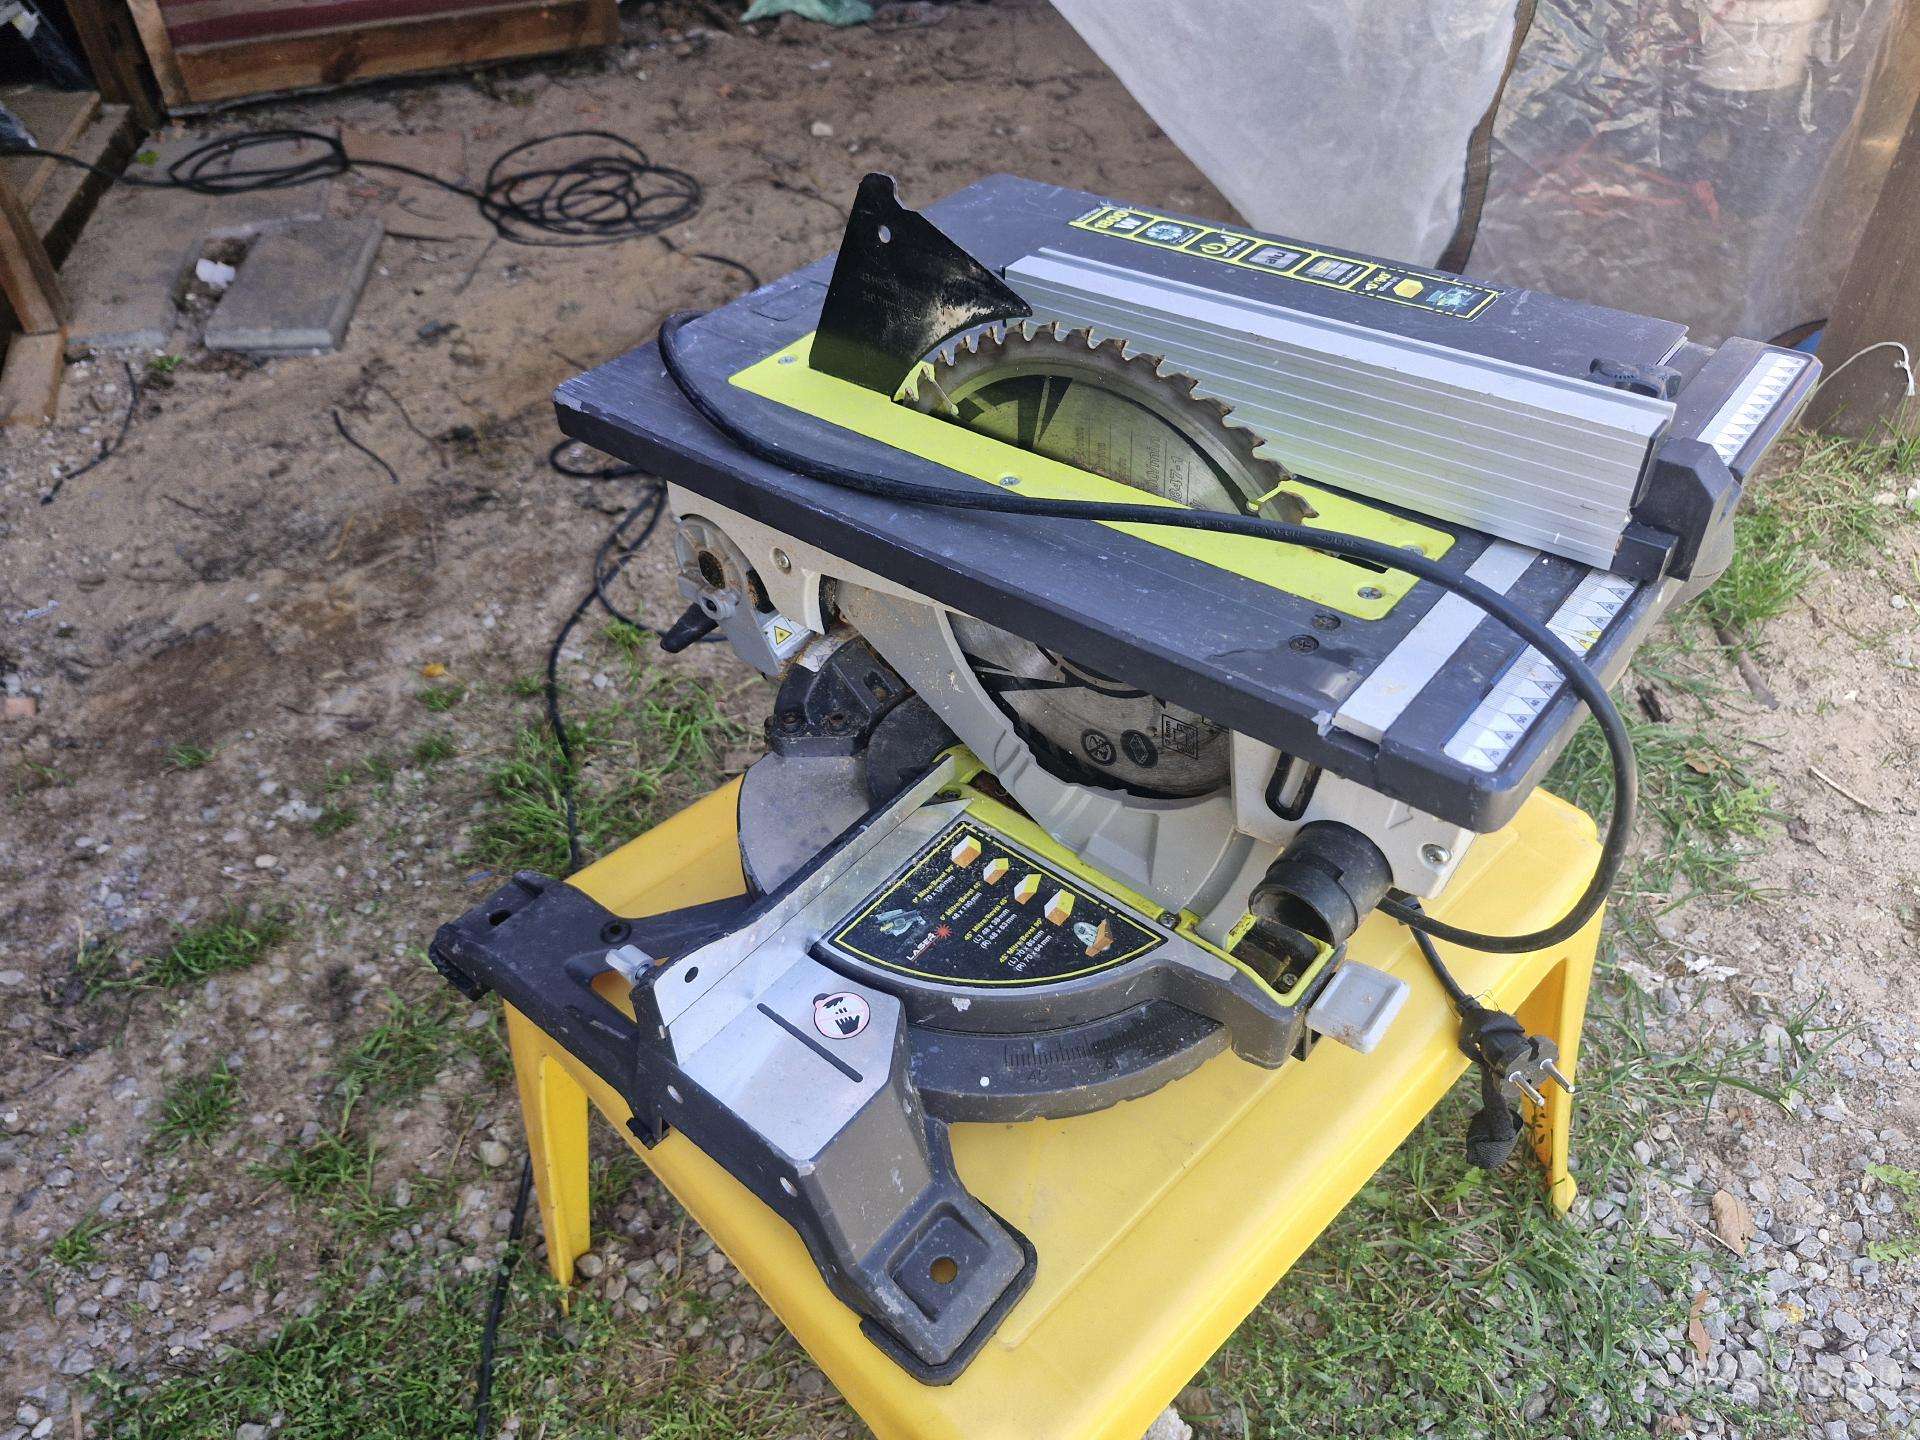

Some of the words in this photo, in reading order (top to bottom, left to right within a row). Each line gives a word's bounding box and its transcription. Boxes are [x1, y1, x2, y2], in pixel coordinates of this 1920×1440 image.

[906, 932, 937, 961] LASER
[1007, 956, 1019, 967] (L)
[1016, 949, 1026, 957] 70
[1024, 953, 1033, 963] 70
